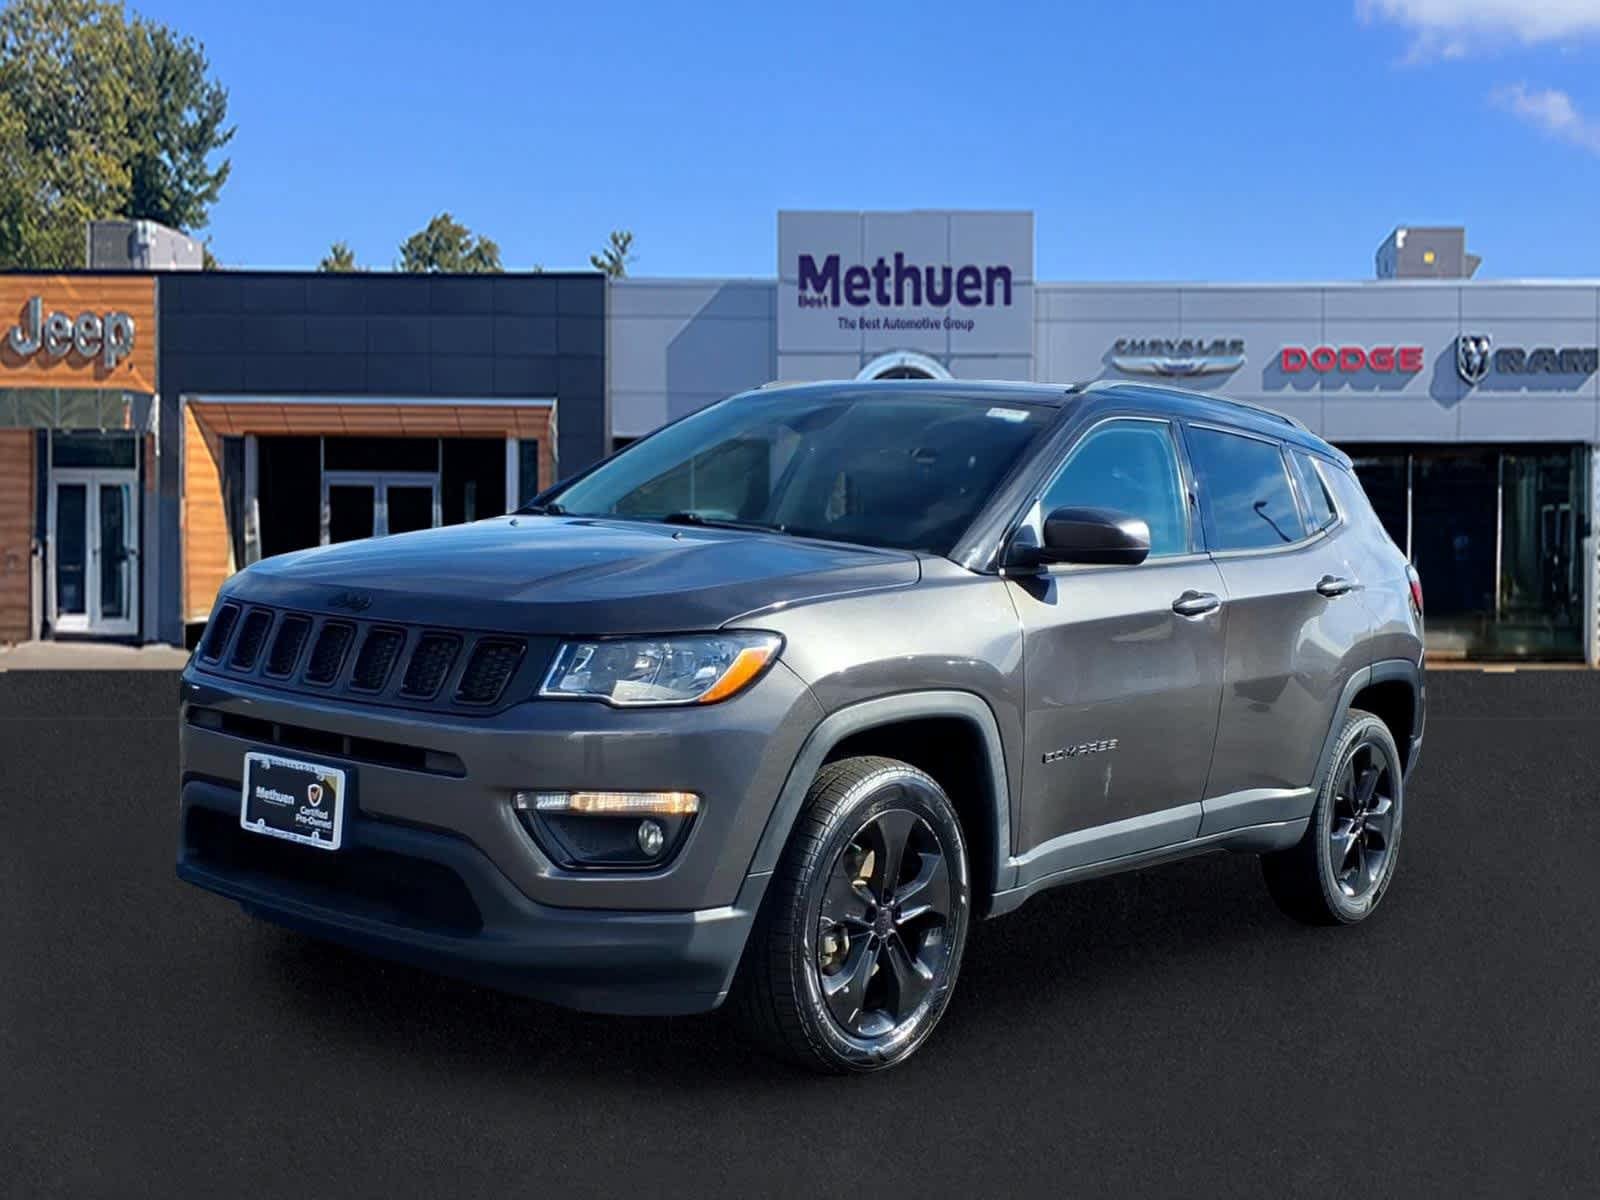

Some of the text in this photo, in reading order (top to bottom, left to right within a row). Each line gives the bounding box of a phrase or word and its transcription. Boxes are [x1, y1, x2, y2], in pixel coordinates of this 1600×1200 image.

[798, 251, 1012, 307] Methuen
[9, 296, 135, 368] Jeep
[838, 316, 975, 332] The Best Automotive Group
[1112, 338, 1245, 356] CHRYSLER
[1282, 347, 1424, 373] DODGE
[1496, 347, 1598, 375] RAM
[256, 786, 295, 806] Methuen
